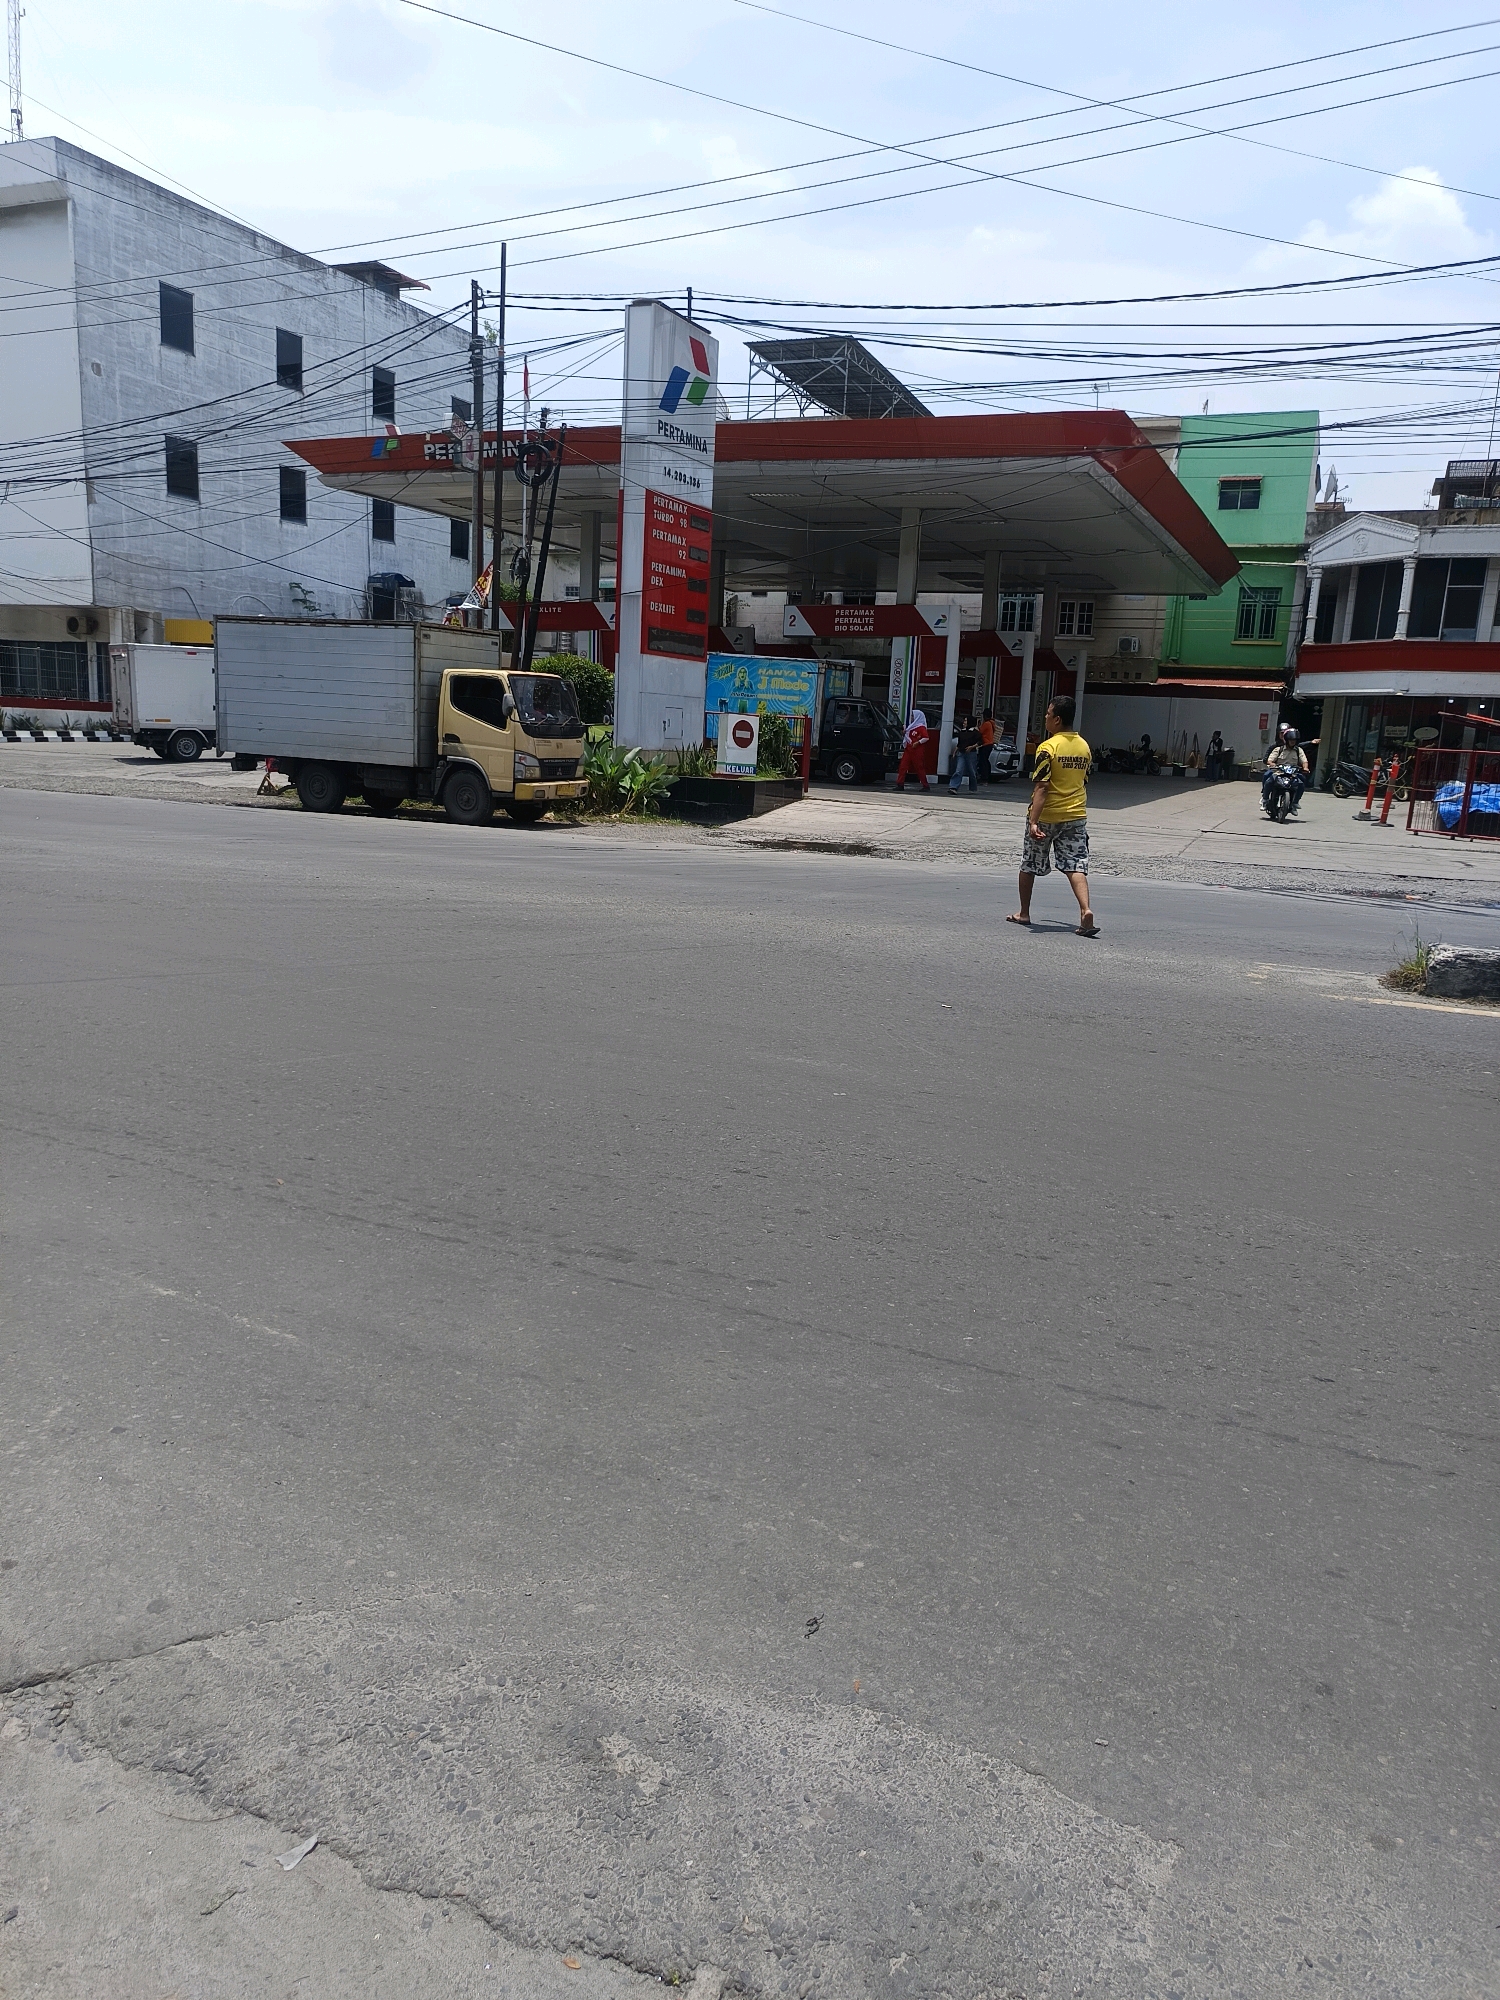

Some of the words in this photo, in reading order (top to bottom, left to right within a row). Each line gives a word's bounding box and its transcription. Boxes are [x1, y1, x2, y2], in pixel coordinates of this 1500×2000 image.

[658, 419, 708, 454] PERTAMINA
[653, 495, 688, 515] PERTAMAX
[653, 509, 675, 524] TURBO
[679, 517, 688, 528] 98
[652, 528, 687, 547] PERTAMAX
[678, 549, 687, 560] 92
[651, 561, 687, 579] PERTAMINA
[650, 575, 664, 587] DEX
[649, 601, 676, 615] DEXLITE
[788, 614, 797, 627] 2
[757, 668, 797, 678] HANYA
[757, 676, 770, 690] J
[770, 677, 810, 692] Mode
[726, 764, 754, 774] KELUAR
